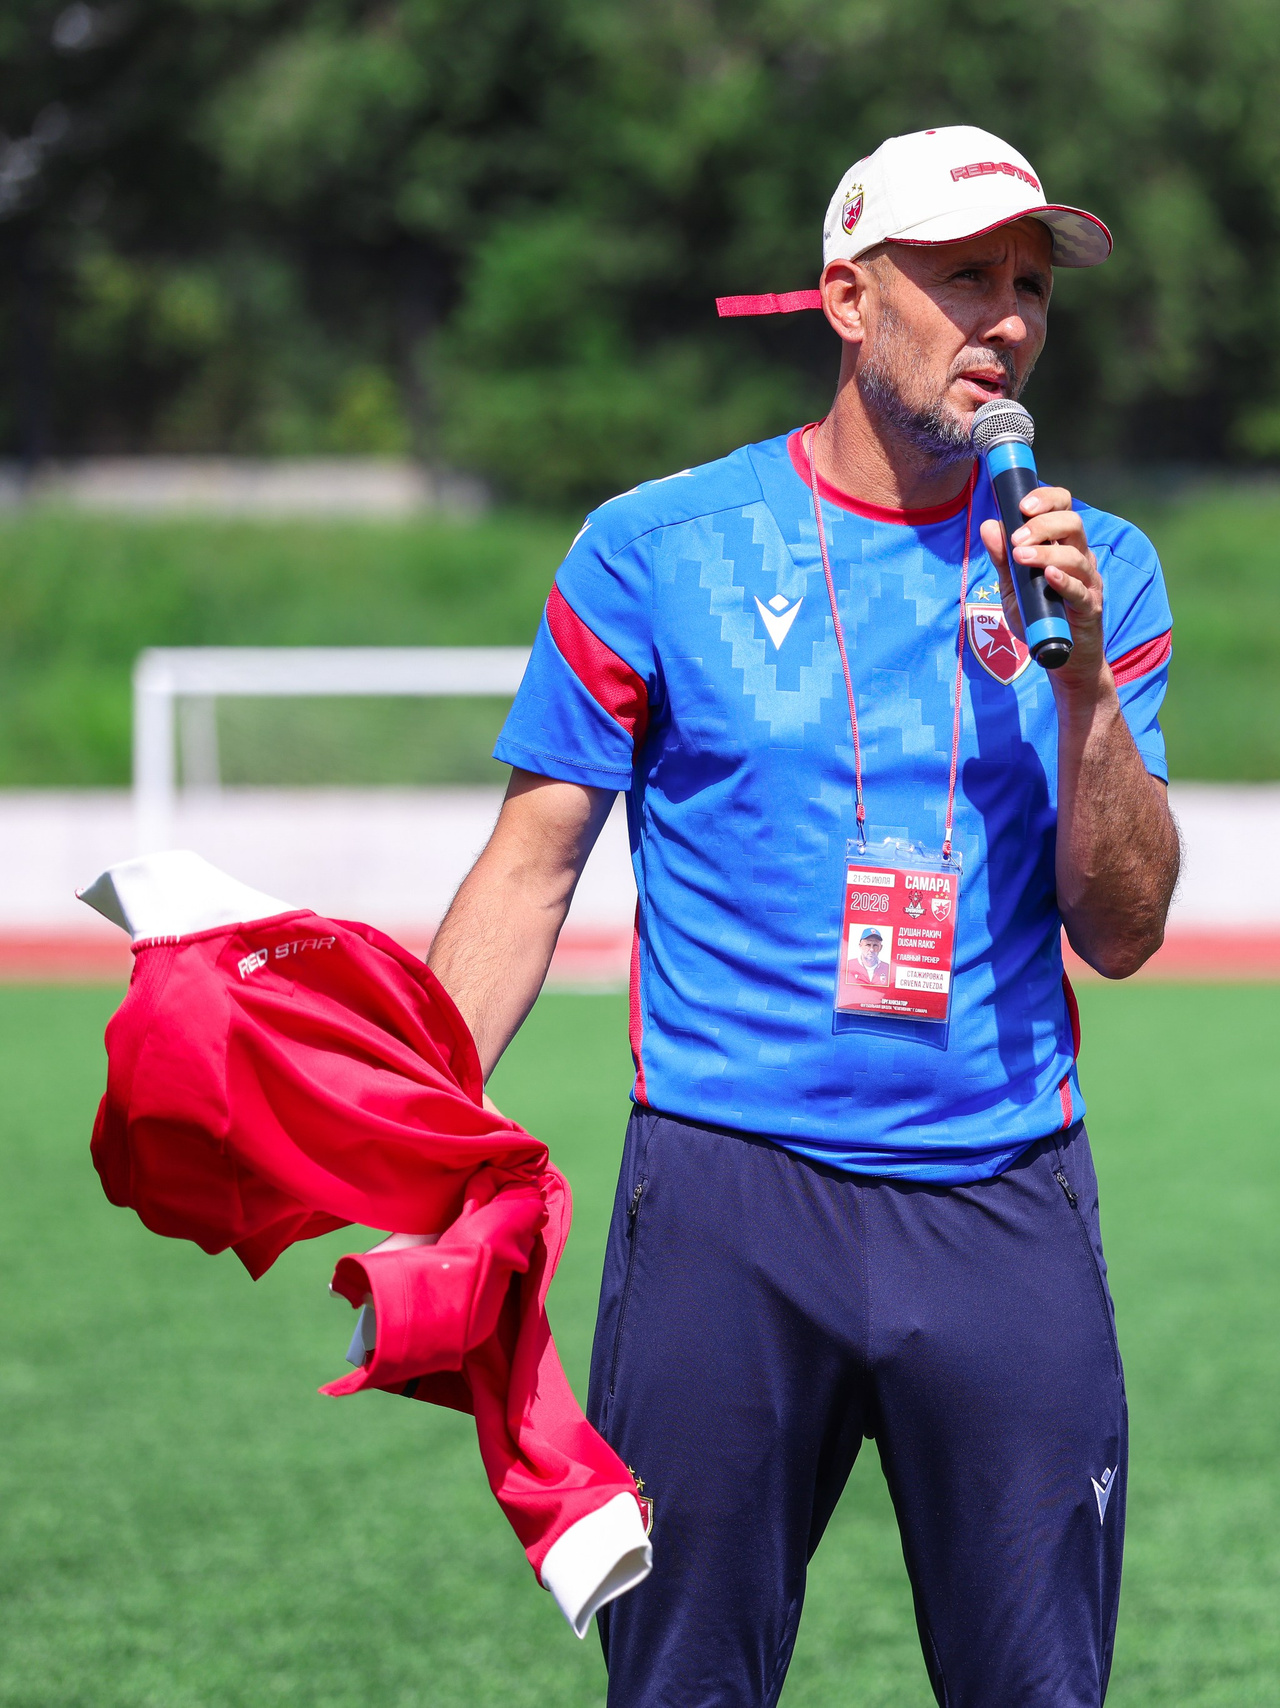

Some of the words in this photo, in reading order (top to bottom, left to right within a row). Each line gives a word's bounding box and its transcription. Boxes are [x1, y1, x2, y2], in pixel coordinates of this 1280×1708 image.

[976, 614, 996, 625] ФК
[853, 874, 872, 883] 21-25
[872, 875, 891, 885] ИЮЛЯ
[905, 875, 951, 893] САМАРА
[850, 891, 890, 913] 2026
[898, 927, 922, 937] ДУШАН
[922, 929, 942, 939] РАКИЧ
[897, 938, 918, 948] DUSAN
[917, 939, 936, 950] RAKIC
[237, 948, 268, 980] RED
[274, 936, 336, 960] STAR
[906, 970, 944, 981] СТАЖИРОВКА
[900, 979, 922, 988] CRVENA
[922, 981, 943, 990] ZVEZDA
